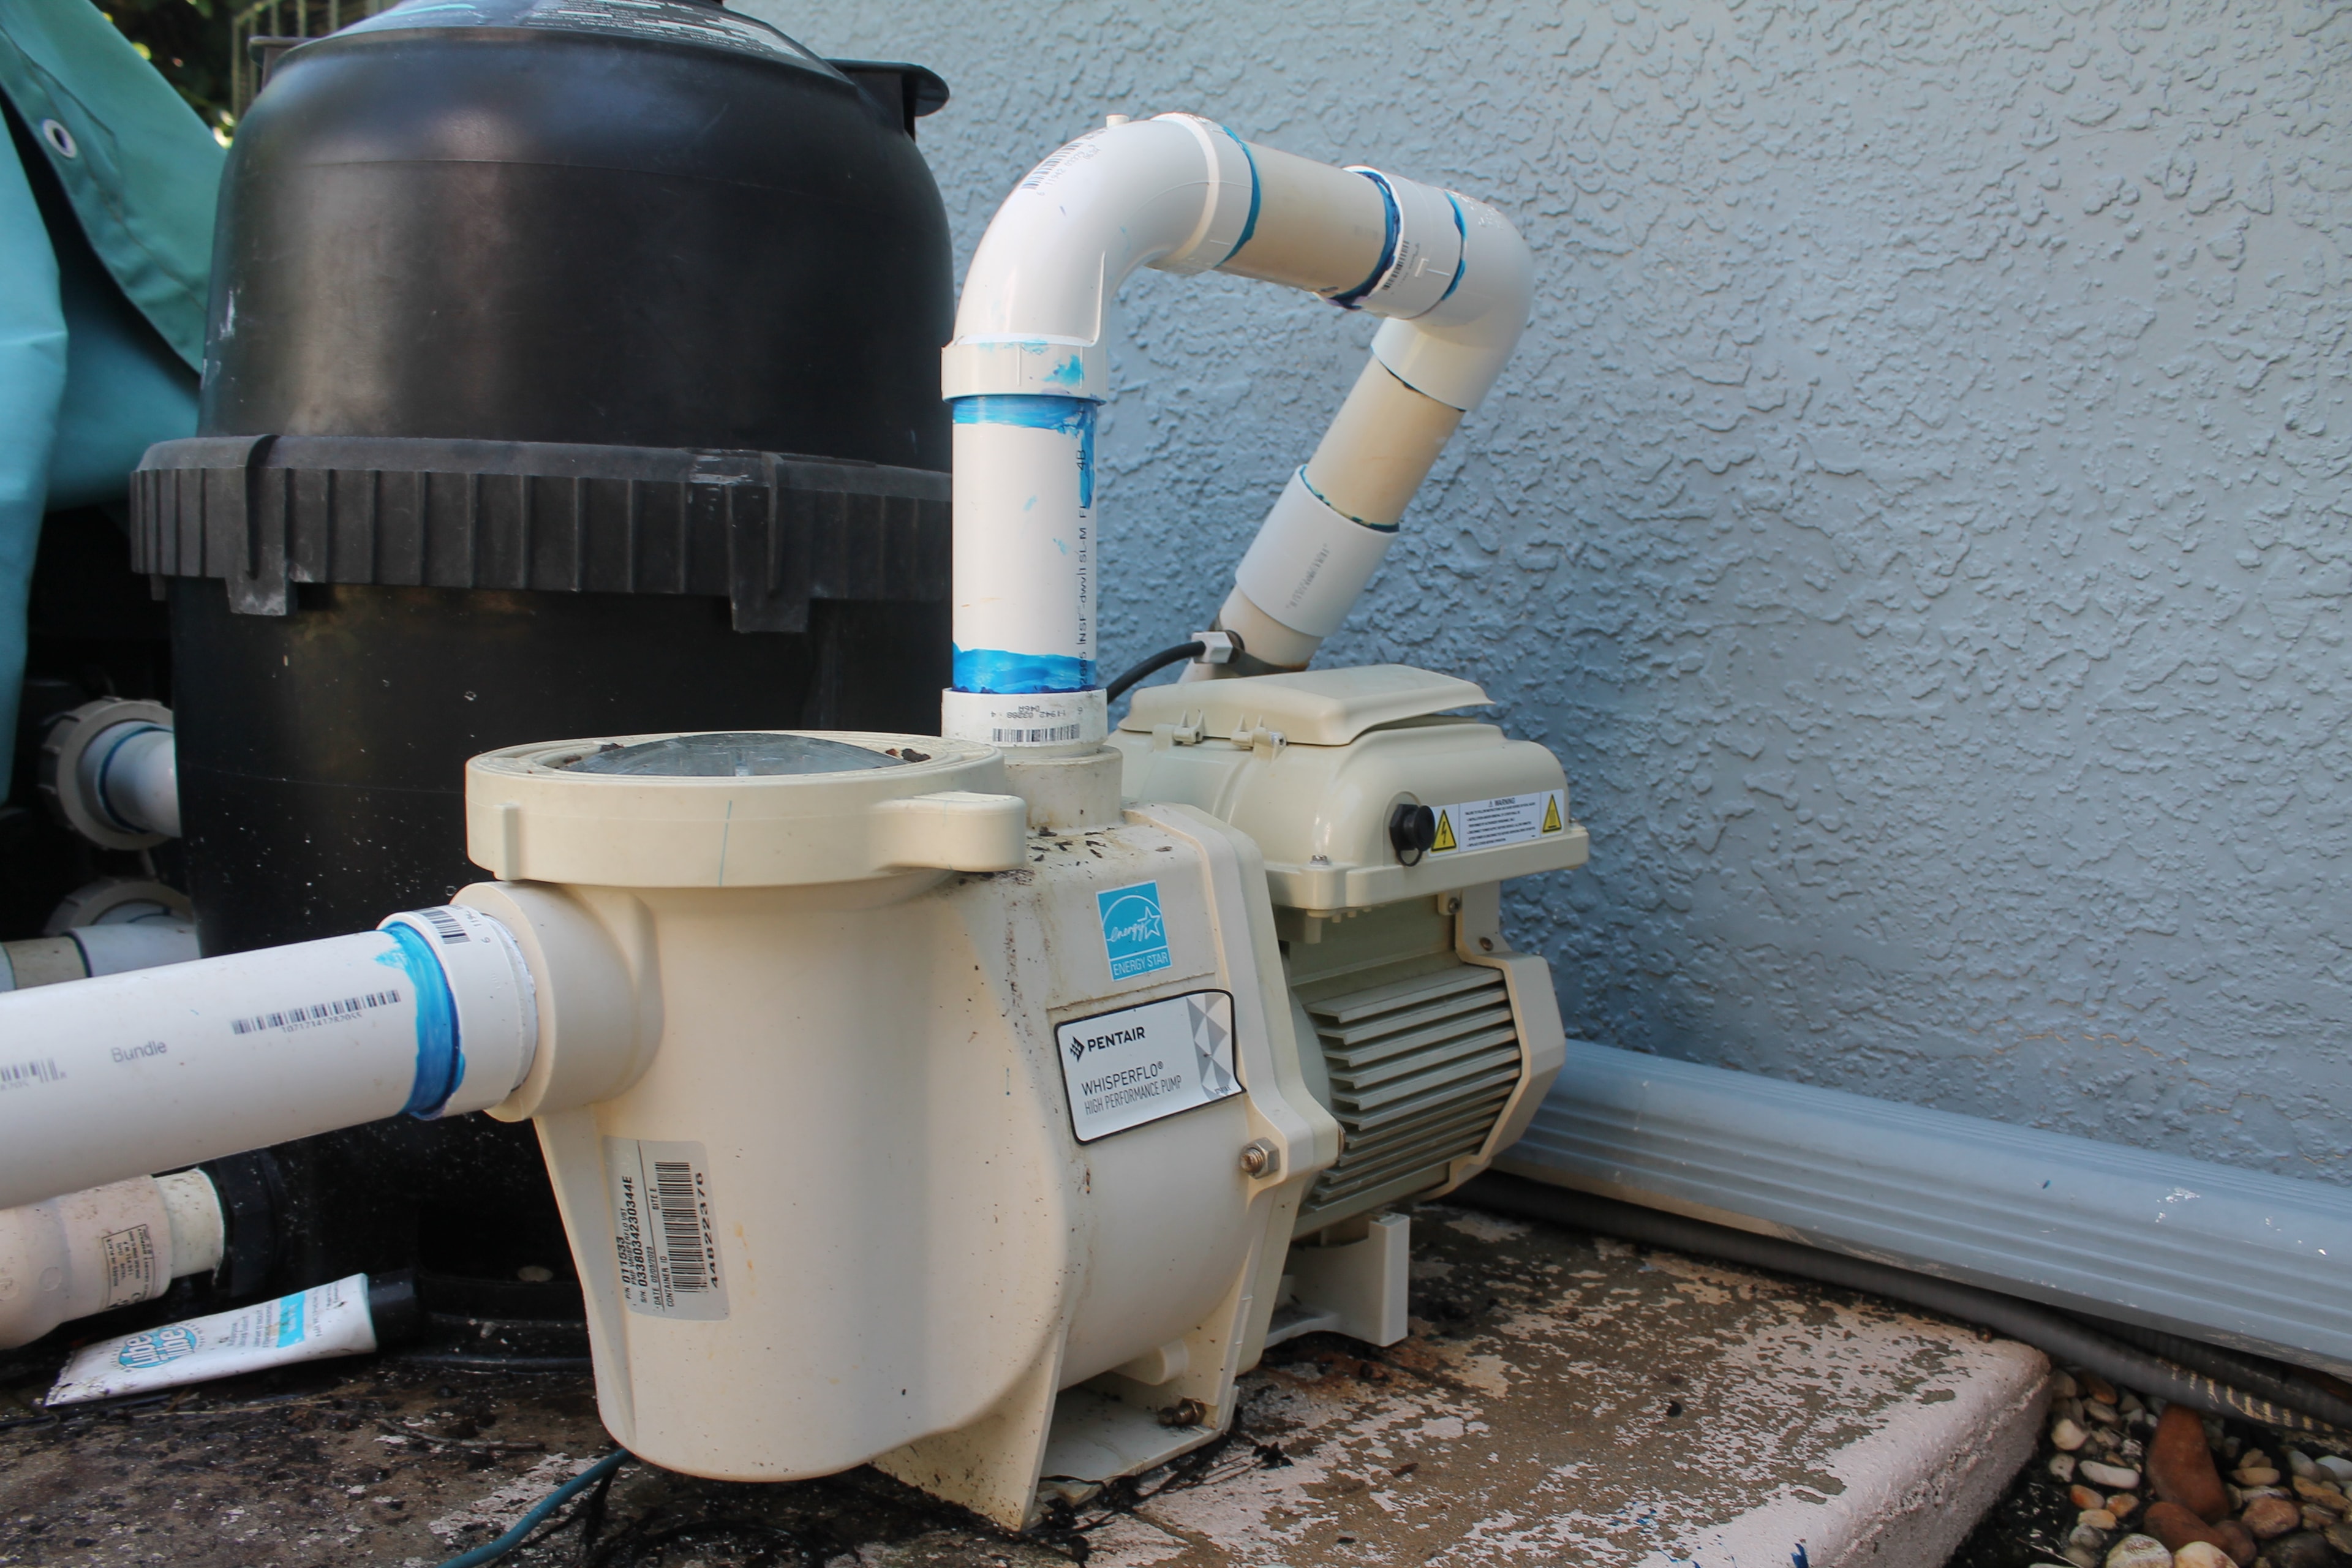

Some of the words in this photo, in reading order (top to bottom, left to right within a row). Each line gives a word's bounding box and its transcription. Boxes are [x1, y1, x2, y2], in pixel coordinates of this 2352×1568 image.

[1076, 449, 1086, 471] 4B
[1113, 957, 1145, 976] ENERGY
[1147, 952, 1169, 967] STAR
[111, 1040, 167, 1063] Bundle
[1087, 1027, 1145, 1052] PENTAIR
[1084, 1096, 1104, 1115] HIGH
[1105, 1081, 1160, 1110] PERFORMANCE
[1161, 1074, 1182, 1093] PUMP
[651, 1195, 660, 1210] SITE
[622, 1176, 648, 1287] 0338034230344E
[622, 1222, 635, 1268] WHISPERFLO
[616, 1236, 631, 1284] 011533
[646, 1246, 658, 1283] 02/03/2023
[652, 1287, 662, 1305] DATE
[662, 1267, 674, 1307] CONTAINER
[121, 1335, 160, 1367] Lube
[156, 1329, 195, 1361] Tube
